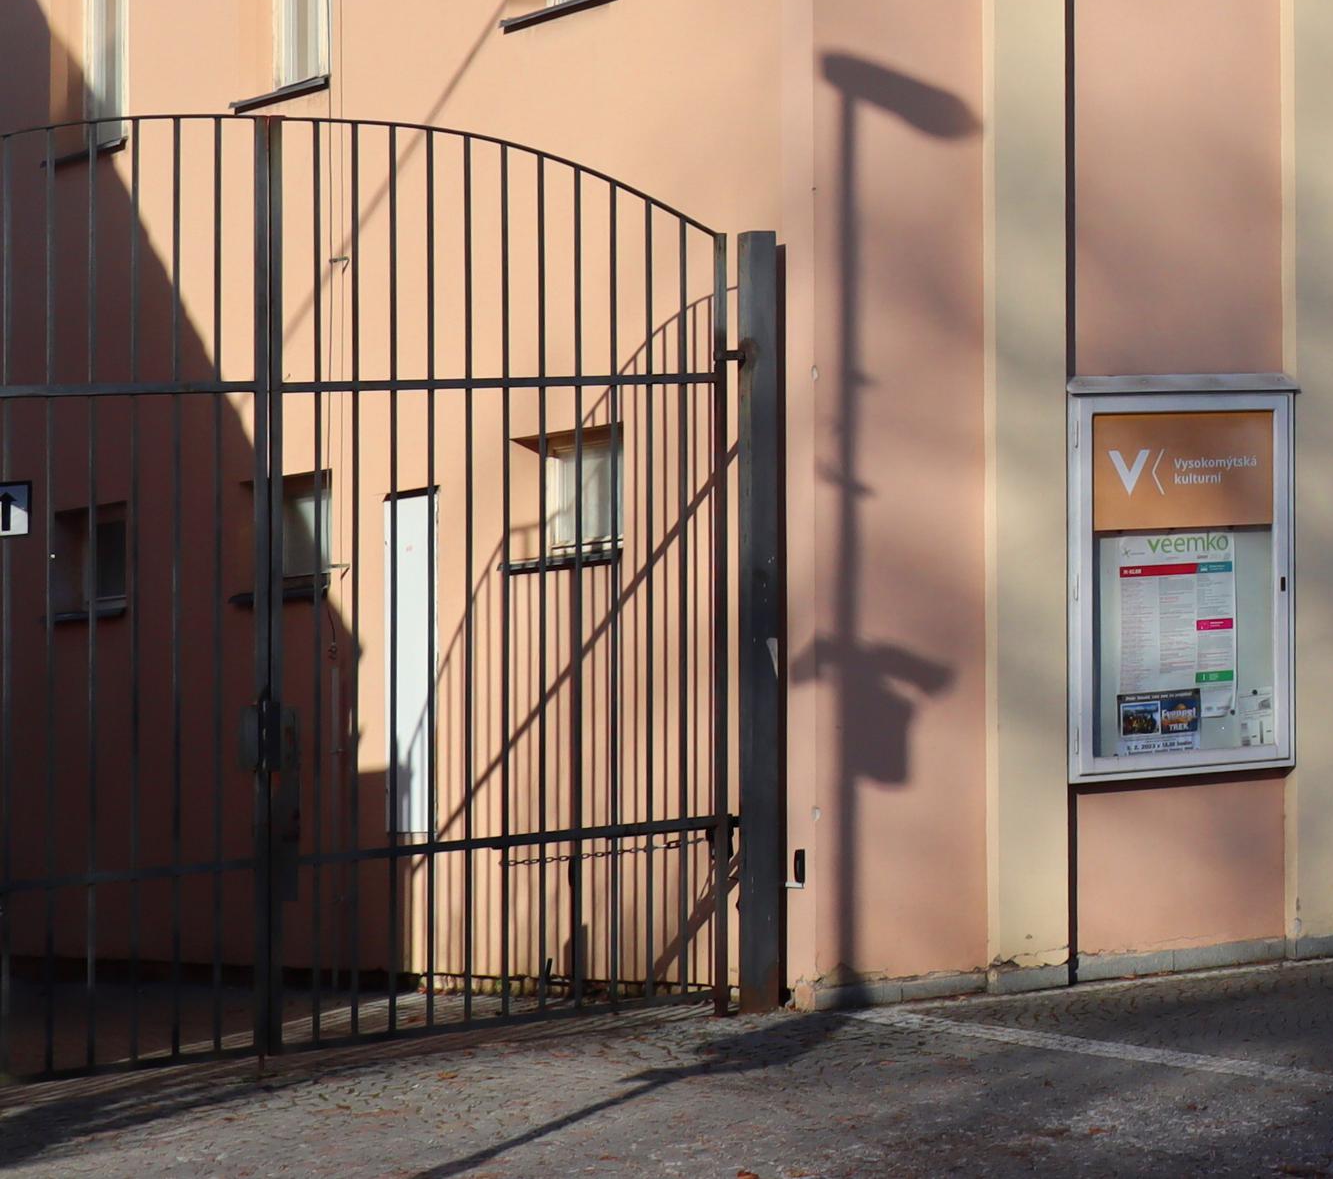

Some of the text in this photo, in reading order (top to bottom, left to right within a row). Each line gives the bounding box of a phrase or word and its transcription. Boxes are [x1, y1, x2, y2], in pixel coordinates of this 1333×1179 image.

[1174, 455, 1257, 472] Vysokomýtská
[1174, 472, 1222, 485] kulturní
[1147, 529, 1229, 554] veemko
